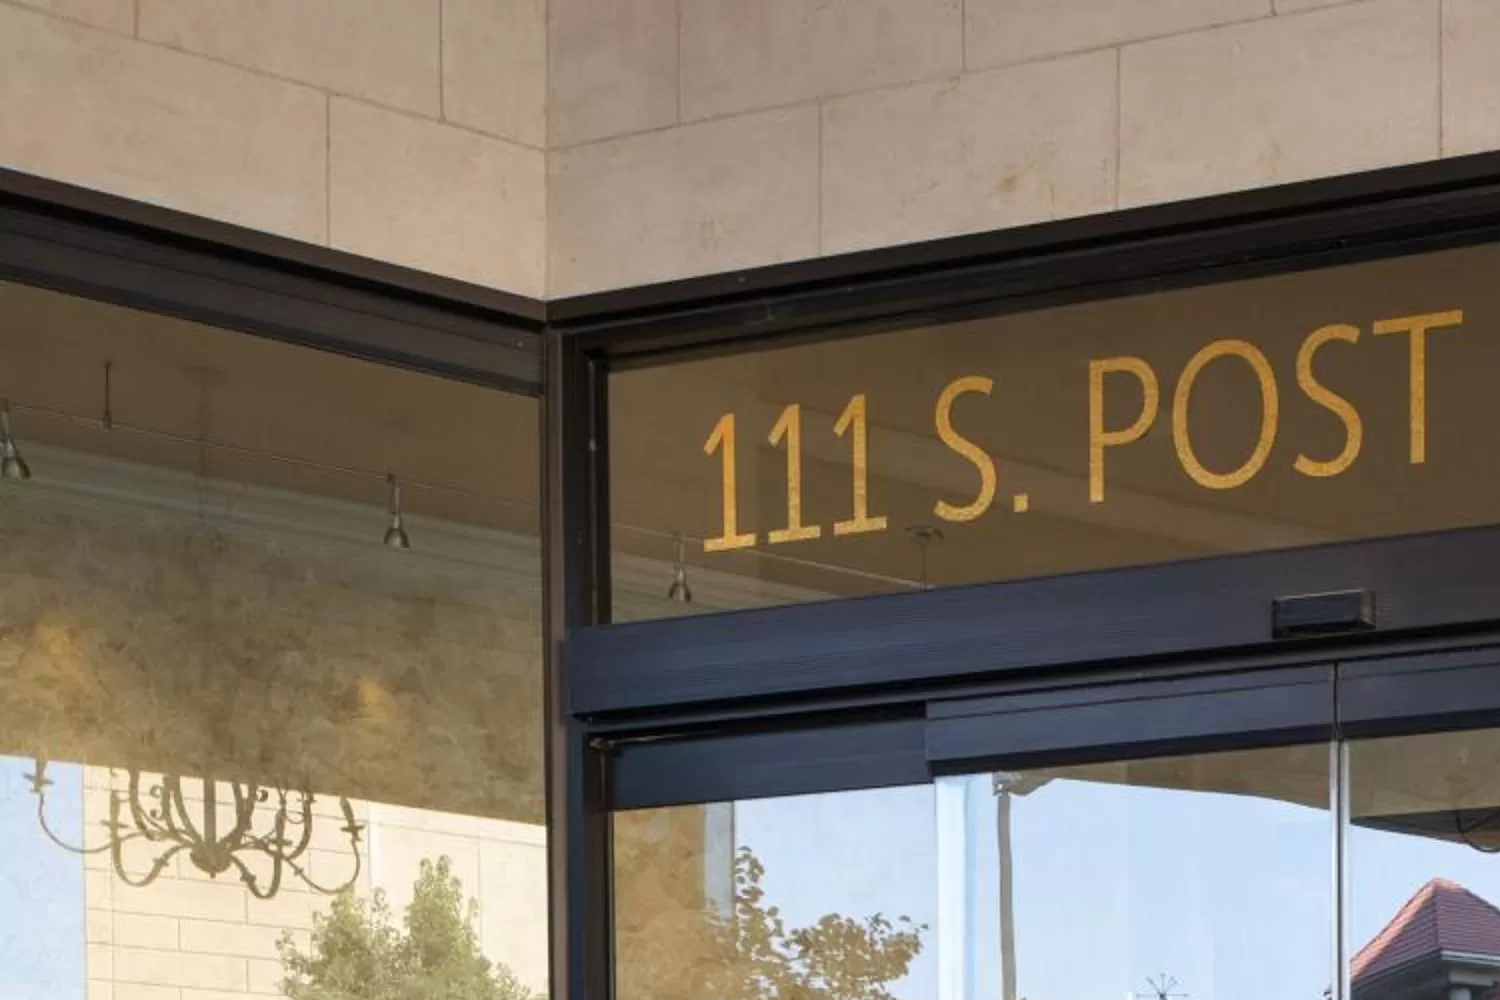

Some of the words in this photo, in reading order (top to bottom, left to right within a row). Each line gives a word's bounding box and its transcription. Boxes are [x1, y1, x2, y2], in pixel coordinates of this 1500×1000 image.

[704, 393, 887, 552] 111
[933, 375, 1029, 522] S.
[1088, 309, 1463, 504] POST
